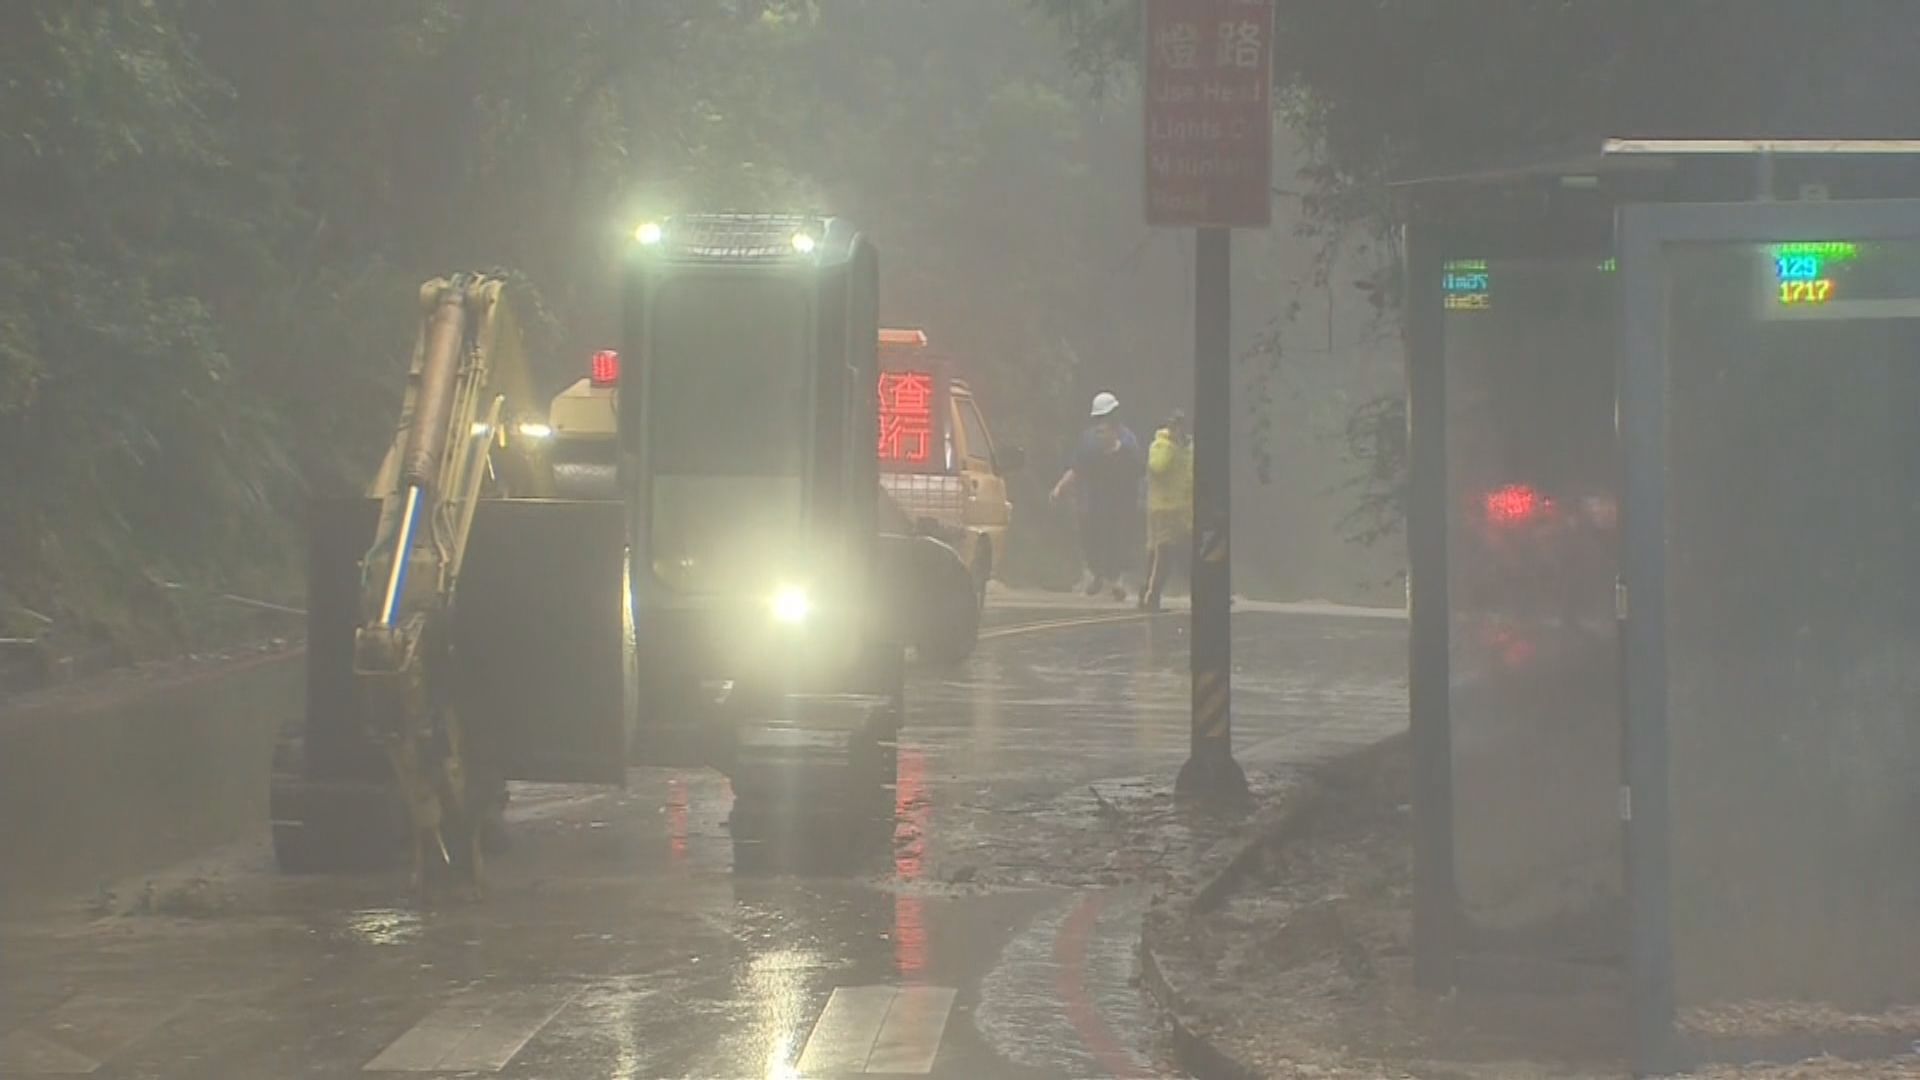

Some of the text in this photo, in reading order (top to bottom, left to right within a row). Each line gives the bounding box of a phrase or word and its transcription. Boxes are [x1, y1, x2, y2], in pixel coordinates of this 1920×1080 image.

[1151, 118, 1222, 143] Lights
[1778, 256, 1817, 279] 129
[1780, 280, 1831, 302] 1717
[879, 371, 931, 414] 查
[879, 415, 930, 459] 行
